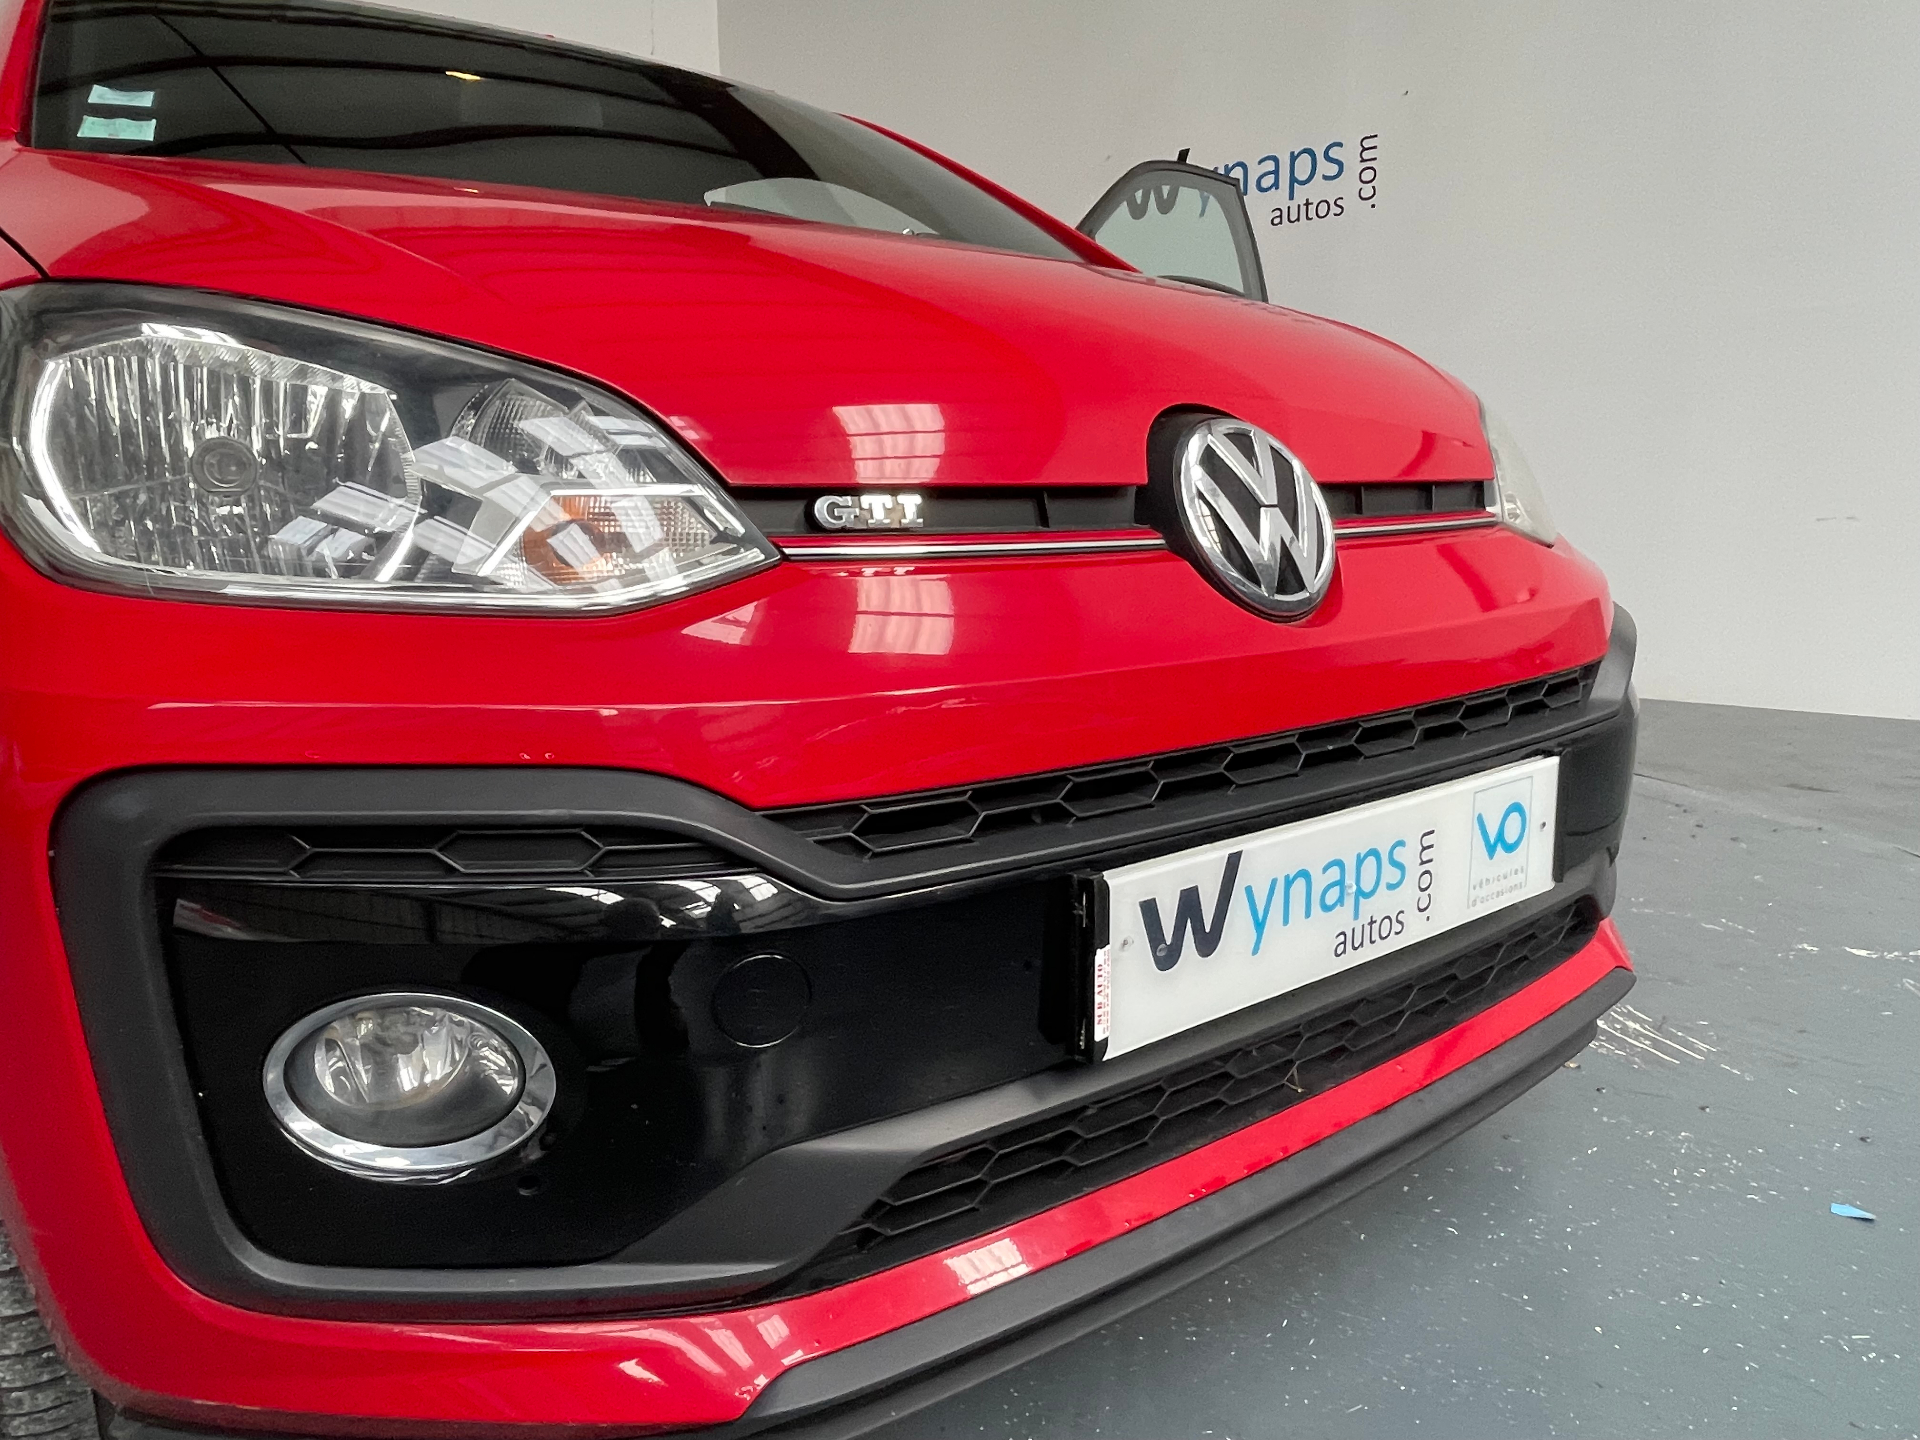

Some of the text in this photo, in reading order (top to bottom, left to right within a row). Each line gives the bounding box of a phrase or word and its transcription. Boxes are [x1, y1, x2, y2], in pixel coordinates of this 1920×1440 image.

[1358, 134, 1378, 209] .com
[1270, 196, 1345, 226] autos
[814, 494, 924, 529] GTI
[1138, 838, 1407, 972] Wynaps
[1416, 829, 1436, 922] .com
[1333, 908, 1406, 958] autos
